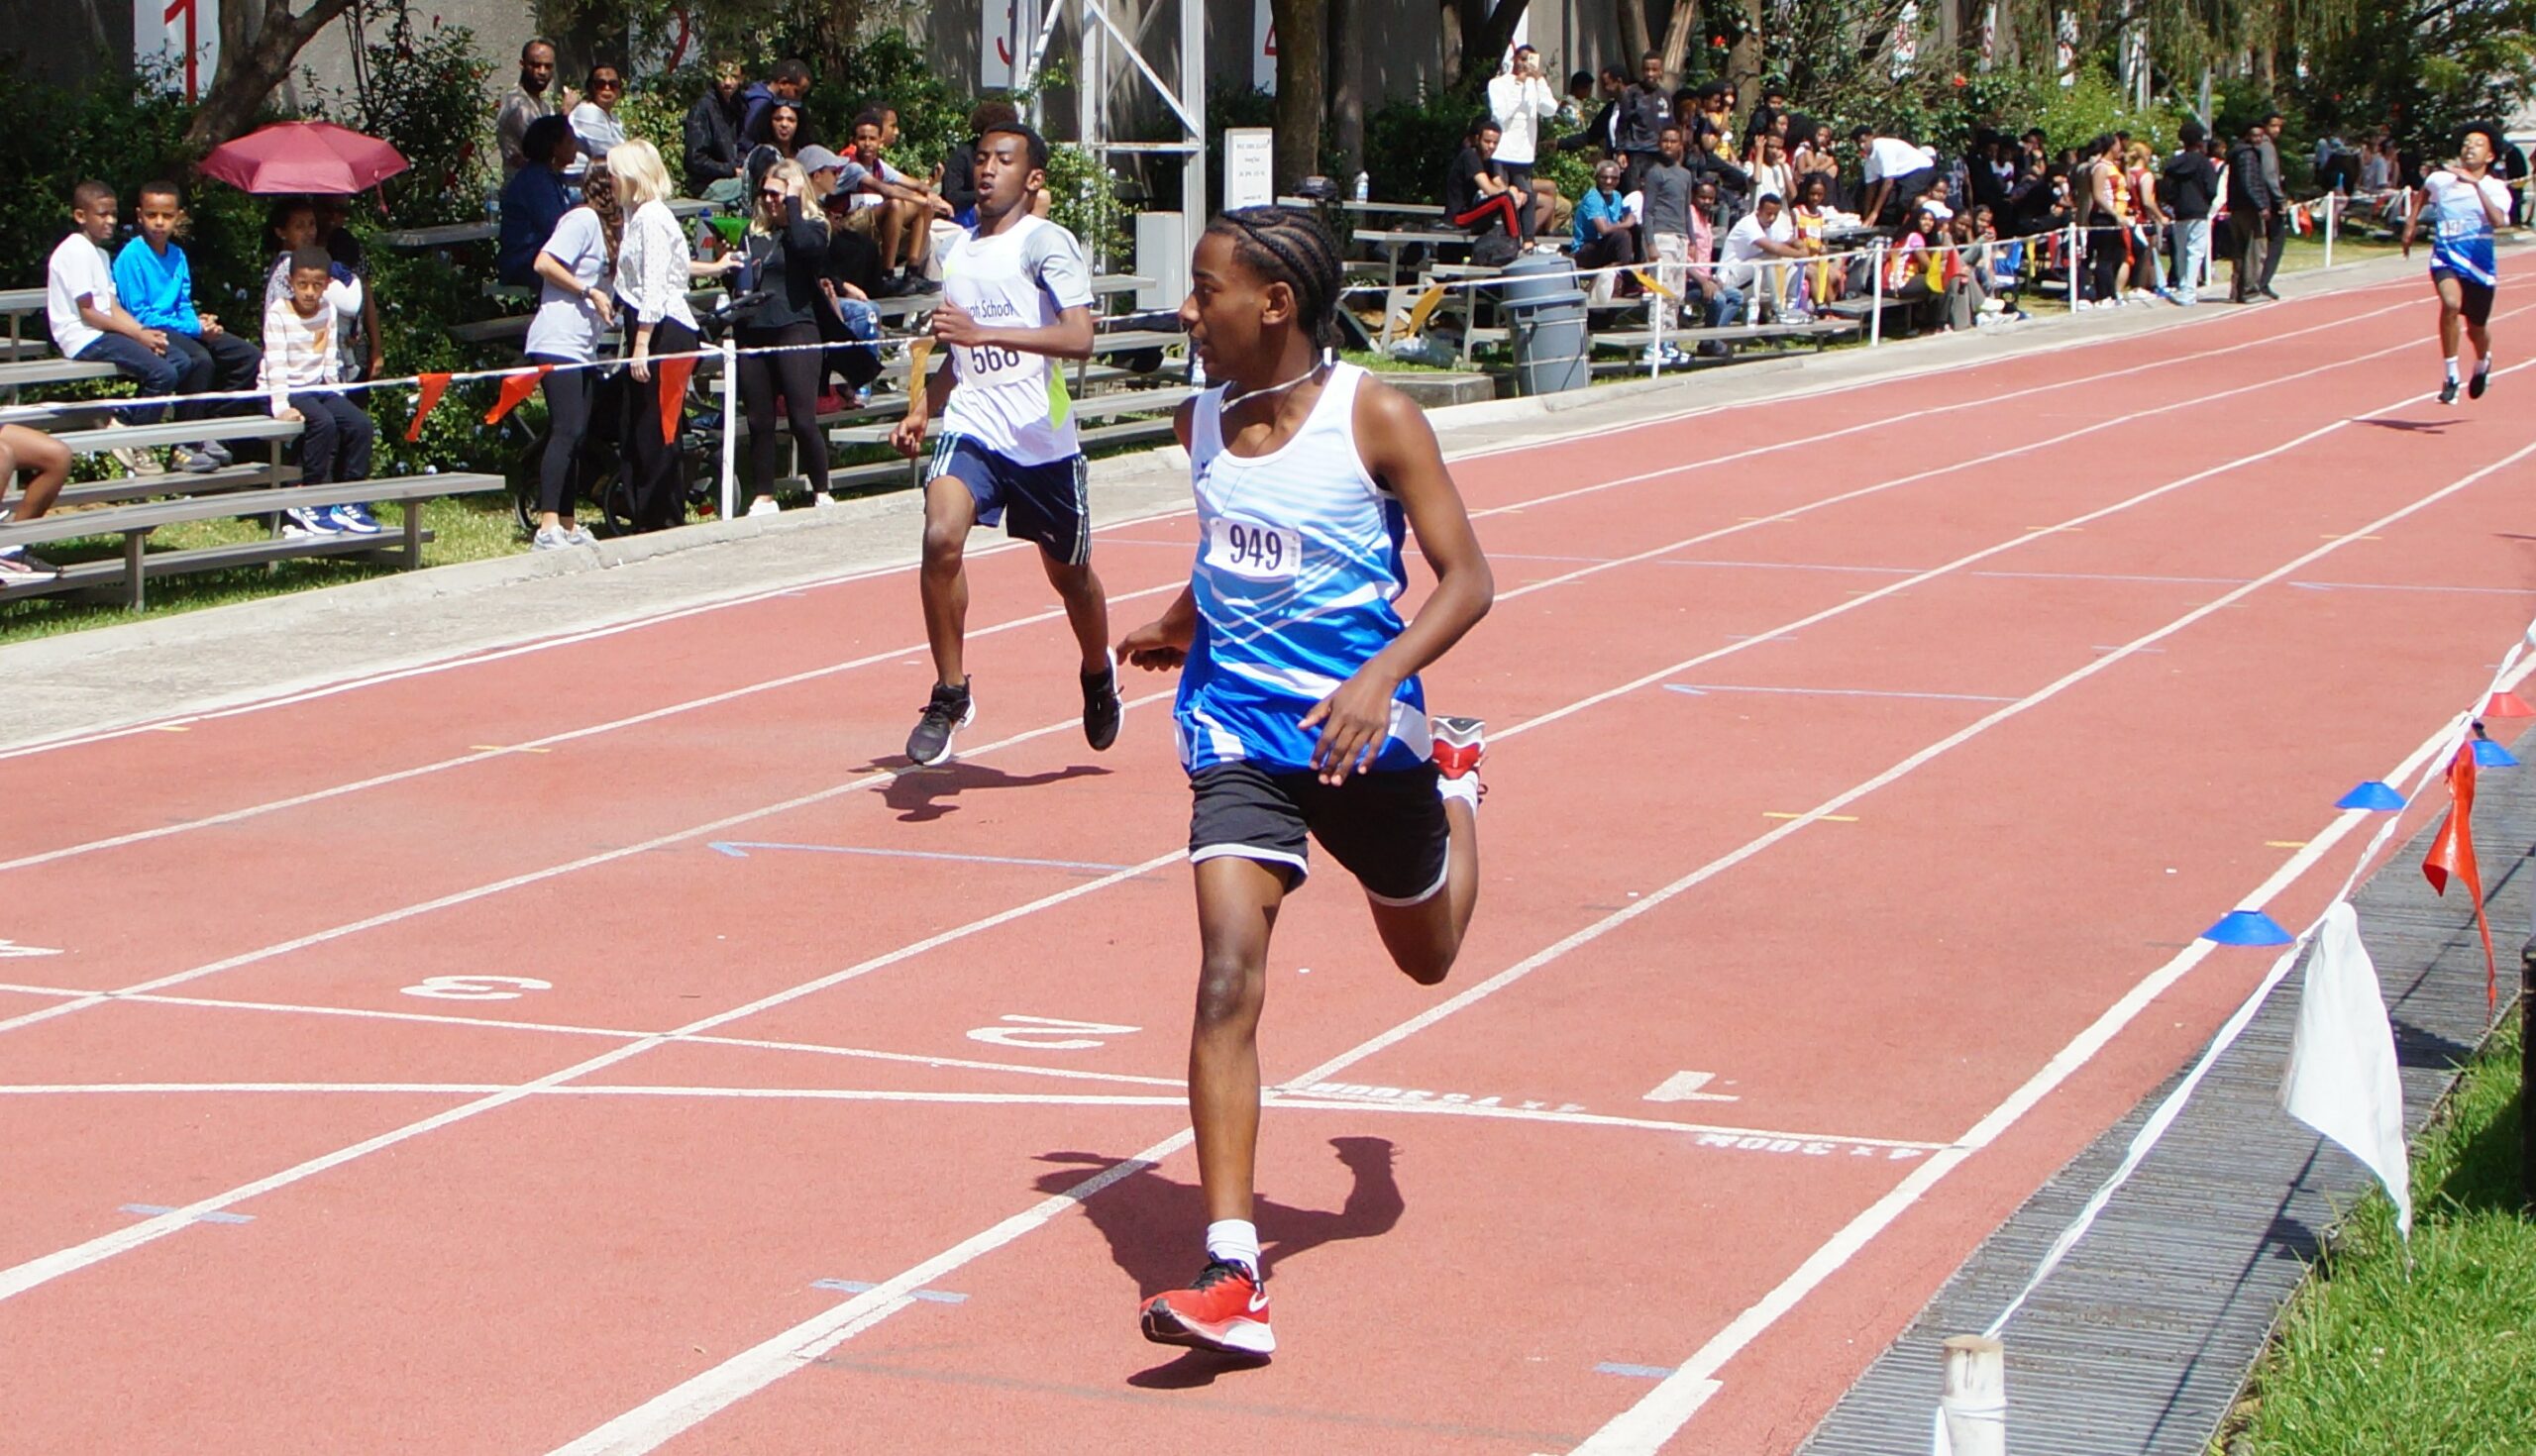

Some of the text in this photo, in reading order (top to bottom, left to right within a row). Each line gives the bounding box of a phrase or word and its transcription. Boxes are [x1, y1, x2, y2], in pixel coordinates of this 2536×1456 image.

[982, 298, 1013, 318] School
[1229, 523, 1283, 572] 949
[399, 975, 552, 1000] 3
[966, 1013, 1143, 1050] 2
